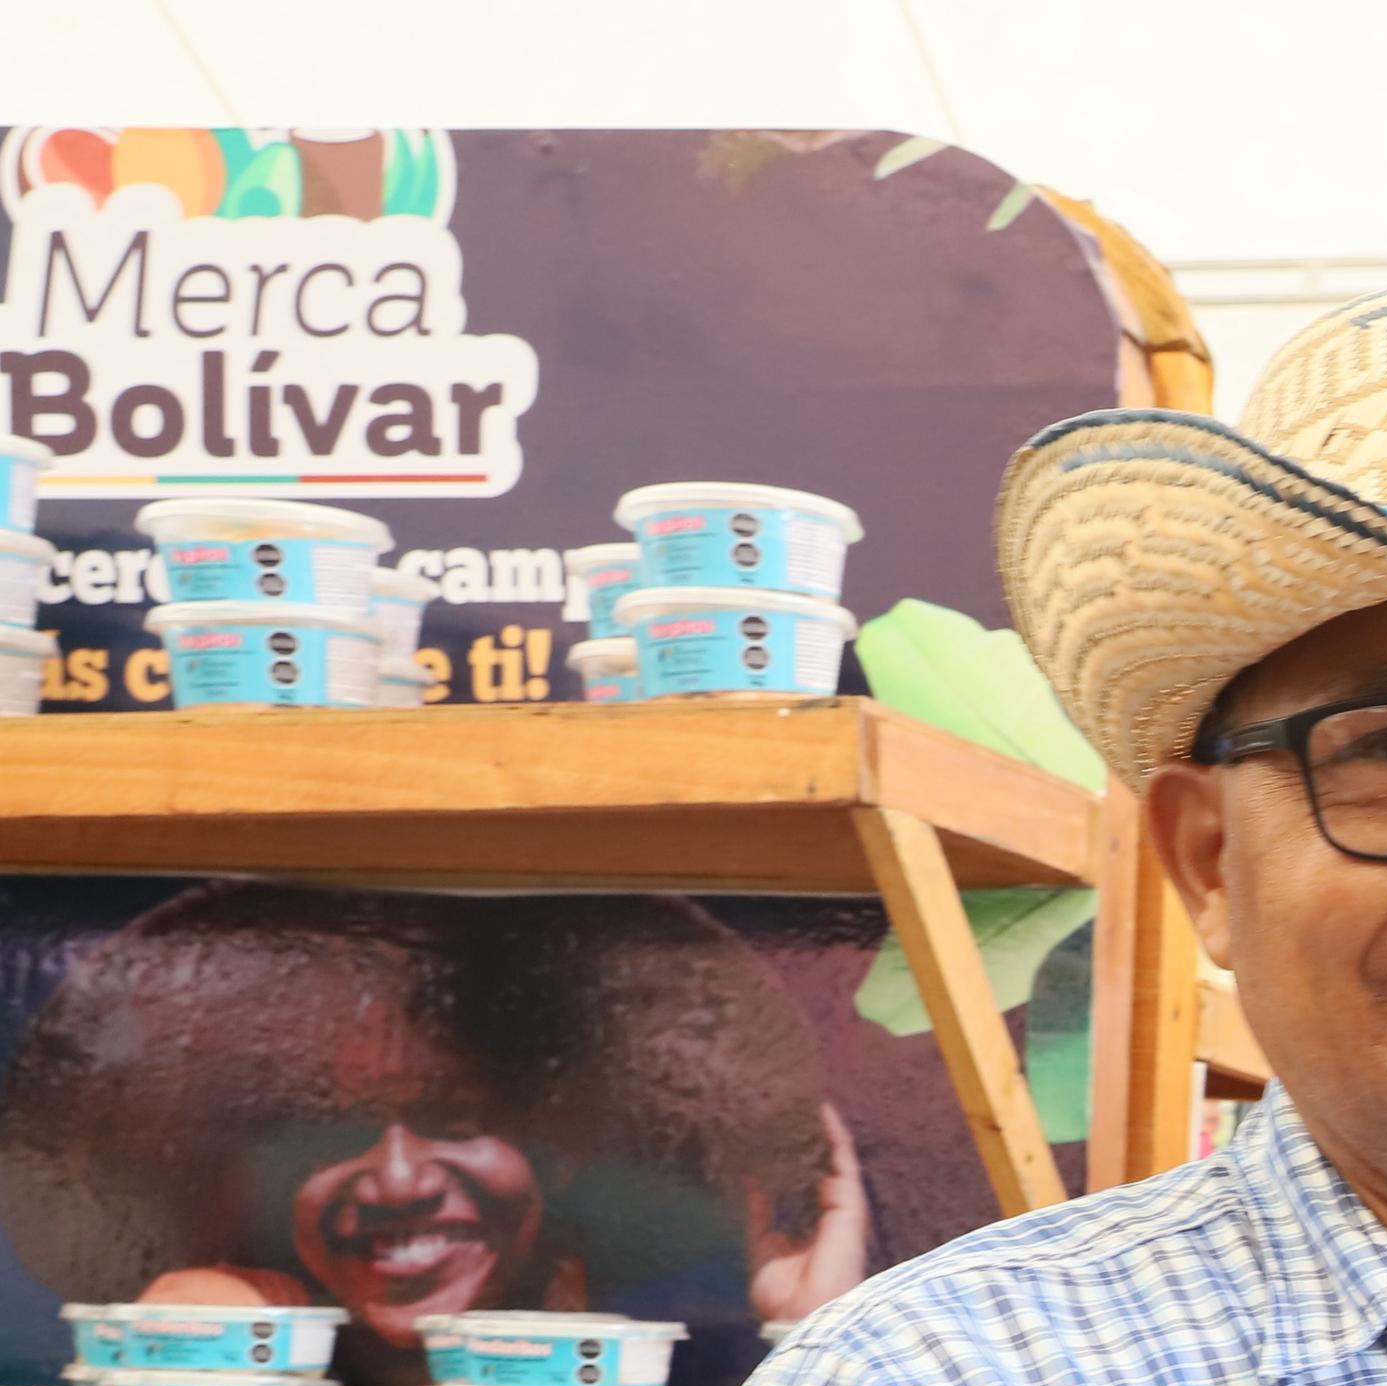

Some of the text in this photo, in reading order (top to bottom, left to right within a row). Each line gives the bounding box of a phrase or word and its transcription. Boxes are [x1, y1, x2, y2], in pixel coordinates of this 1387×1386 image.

[36, 229, 432, 339] Merca
[0, 349, 504, 459] Bolívar
[467, 623, 553, 703] ti!
